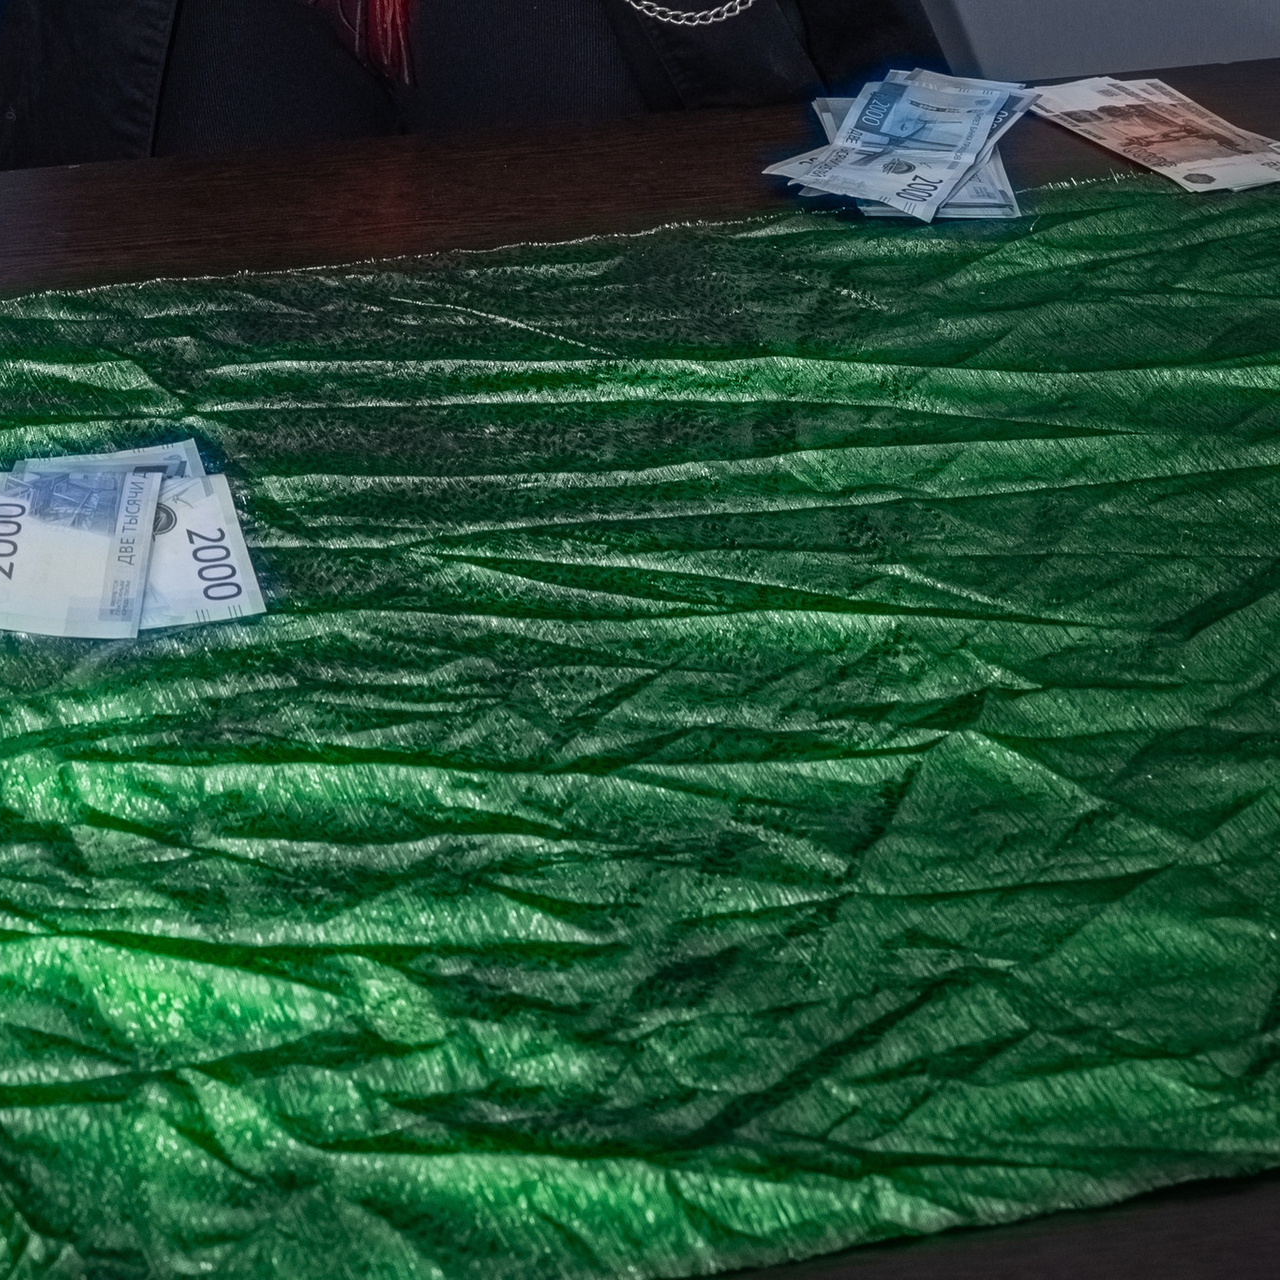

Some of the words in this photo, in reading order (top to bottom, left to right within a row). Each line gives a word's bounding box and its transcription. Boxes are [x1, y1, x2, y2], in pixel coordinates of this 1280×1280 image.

[862, 99, 891, 127] 2000
[895, 174, 943, 202] 2000
[122, 481, 145, 534] ТЫСЯЧИ
[117, 537, 136, 566] ДВЕ
[186, 528, 243, 601] 2000
